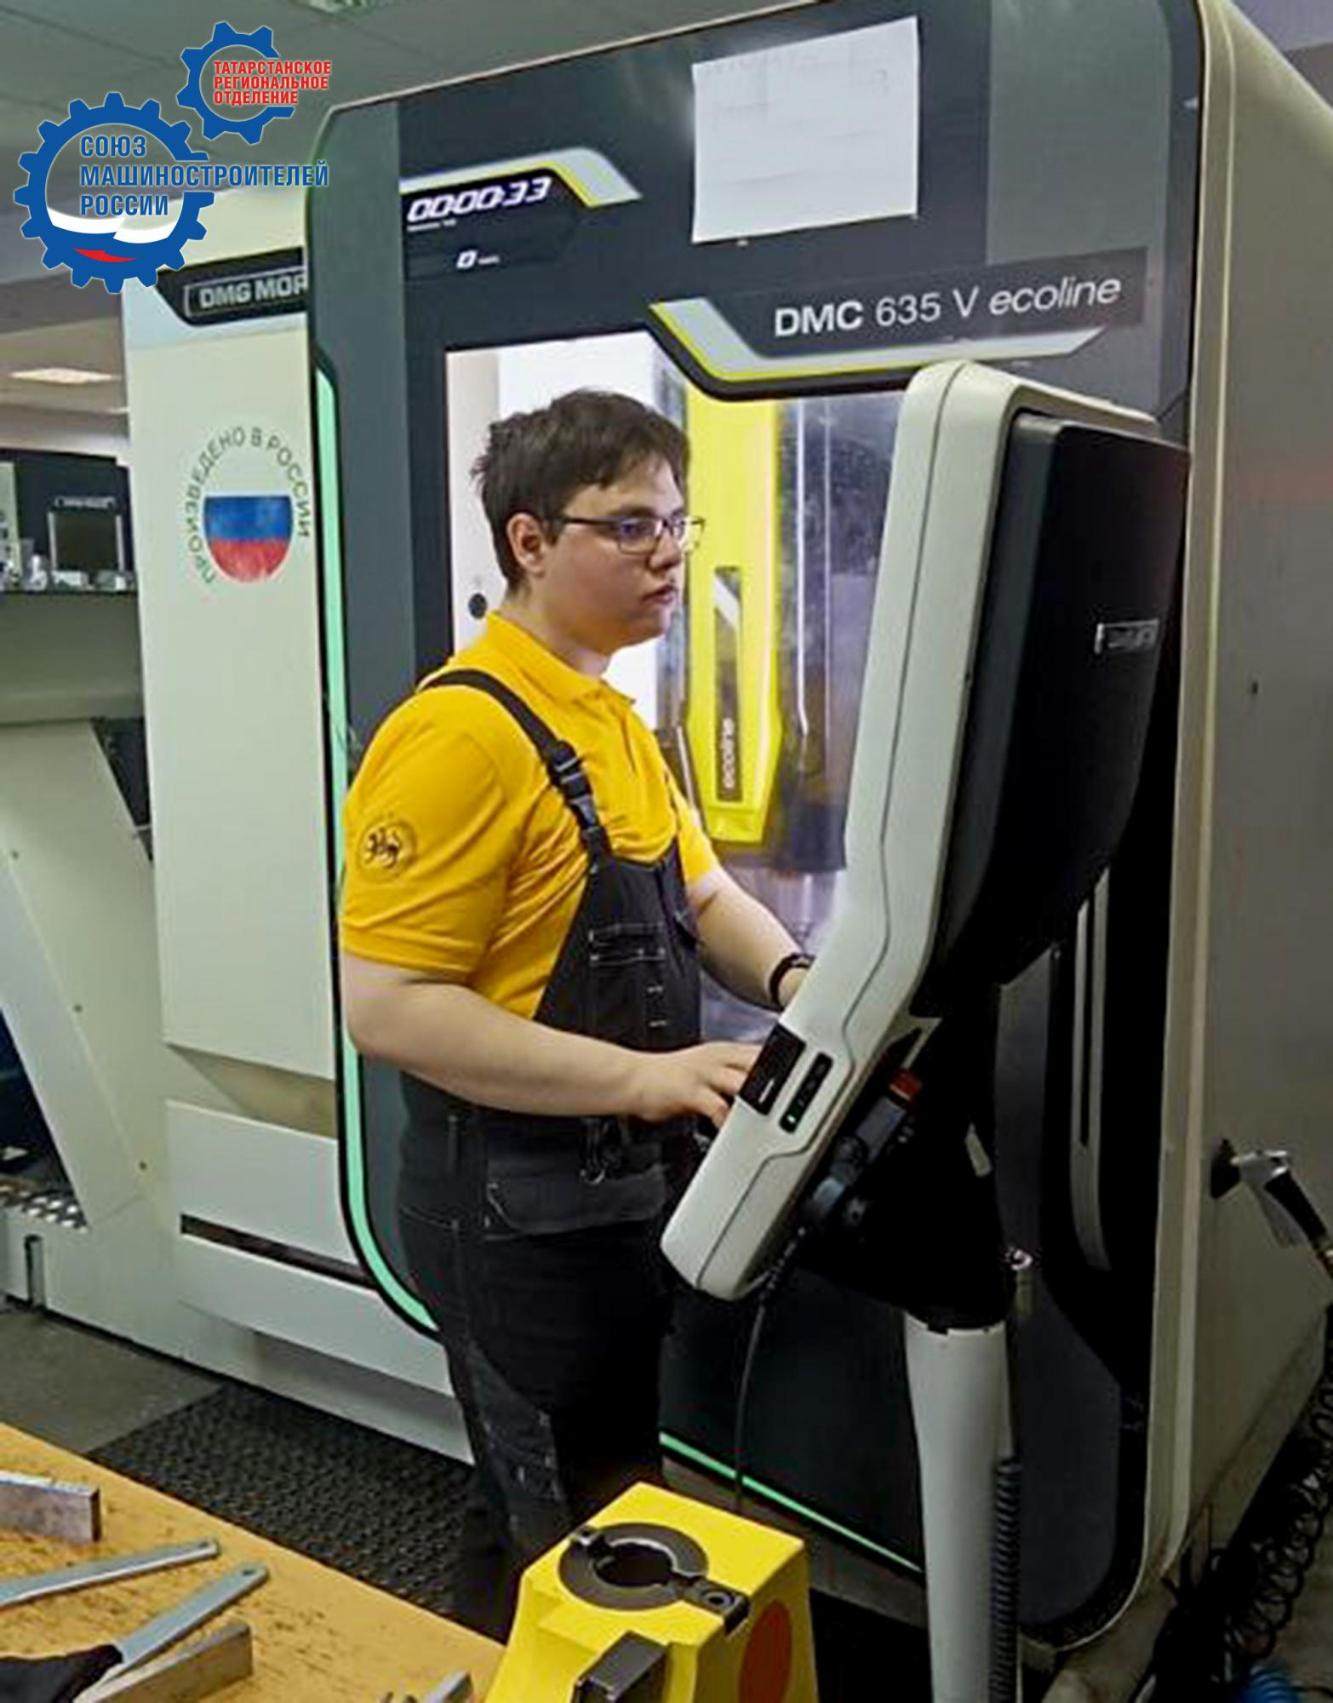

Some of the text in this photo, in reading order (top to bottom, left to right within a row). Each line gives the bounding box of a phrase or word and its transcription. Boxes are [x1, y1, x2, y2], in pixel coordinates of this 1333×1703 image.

[199, 282, 251, 308] DMG
[774, 276, 1121, 337] DMC 635 V ecoline
[185, 426, 311, 584] ПРОИЗВЕДЕНО В РОССИИ
